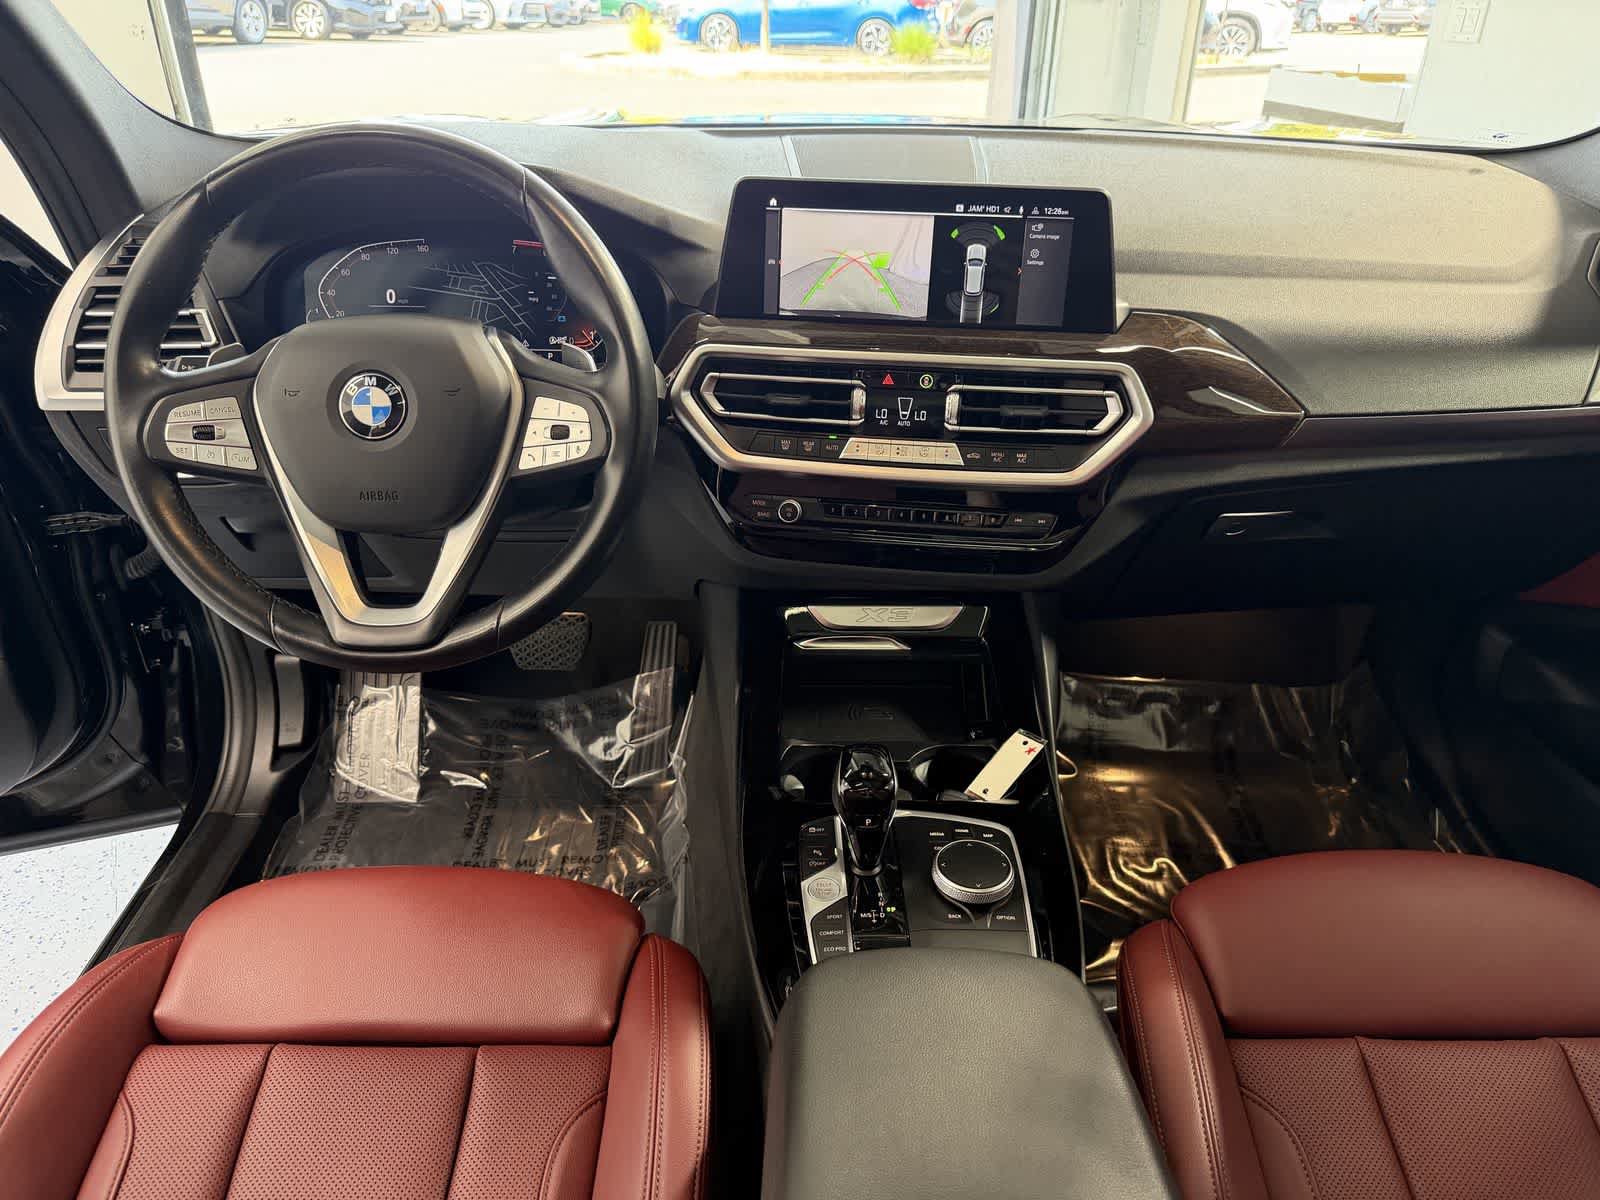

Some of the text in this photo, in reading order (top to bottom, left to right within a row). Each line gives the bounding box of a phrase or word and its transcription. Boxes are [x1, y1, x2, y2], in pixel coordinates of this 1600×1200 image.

[386, 247, 399, 255] 120
[416, 245, 429, 253] 160
[361, 253, 370, 261] 80
[340, 268, 351, 276] 60
[326, 289, 336, 297] 40
[385, 288, 396, 304] 0
[171, 408, 202, 418] RESUME
[209, 406, 235, 414] CANCEL
[875, 408, 887, 419] LO
[914, 410, 926, 421] LO
[359, 490, 399, 502] AIRBAG
[856, 607, 914, 623] X3
[865, 818, 872, 826] P
